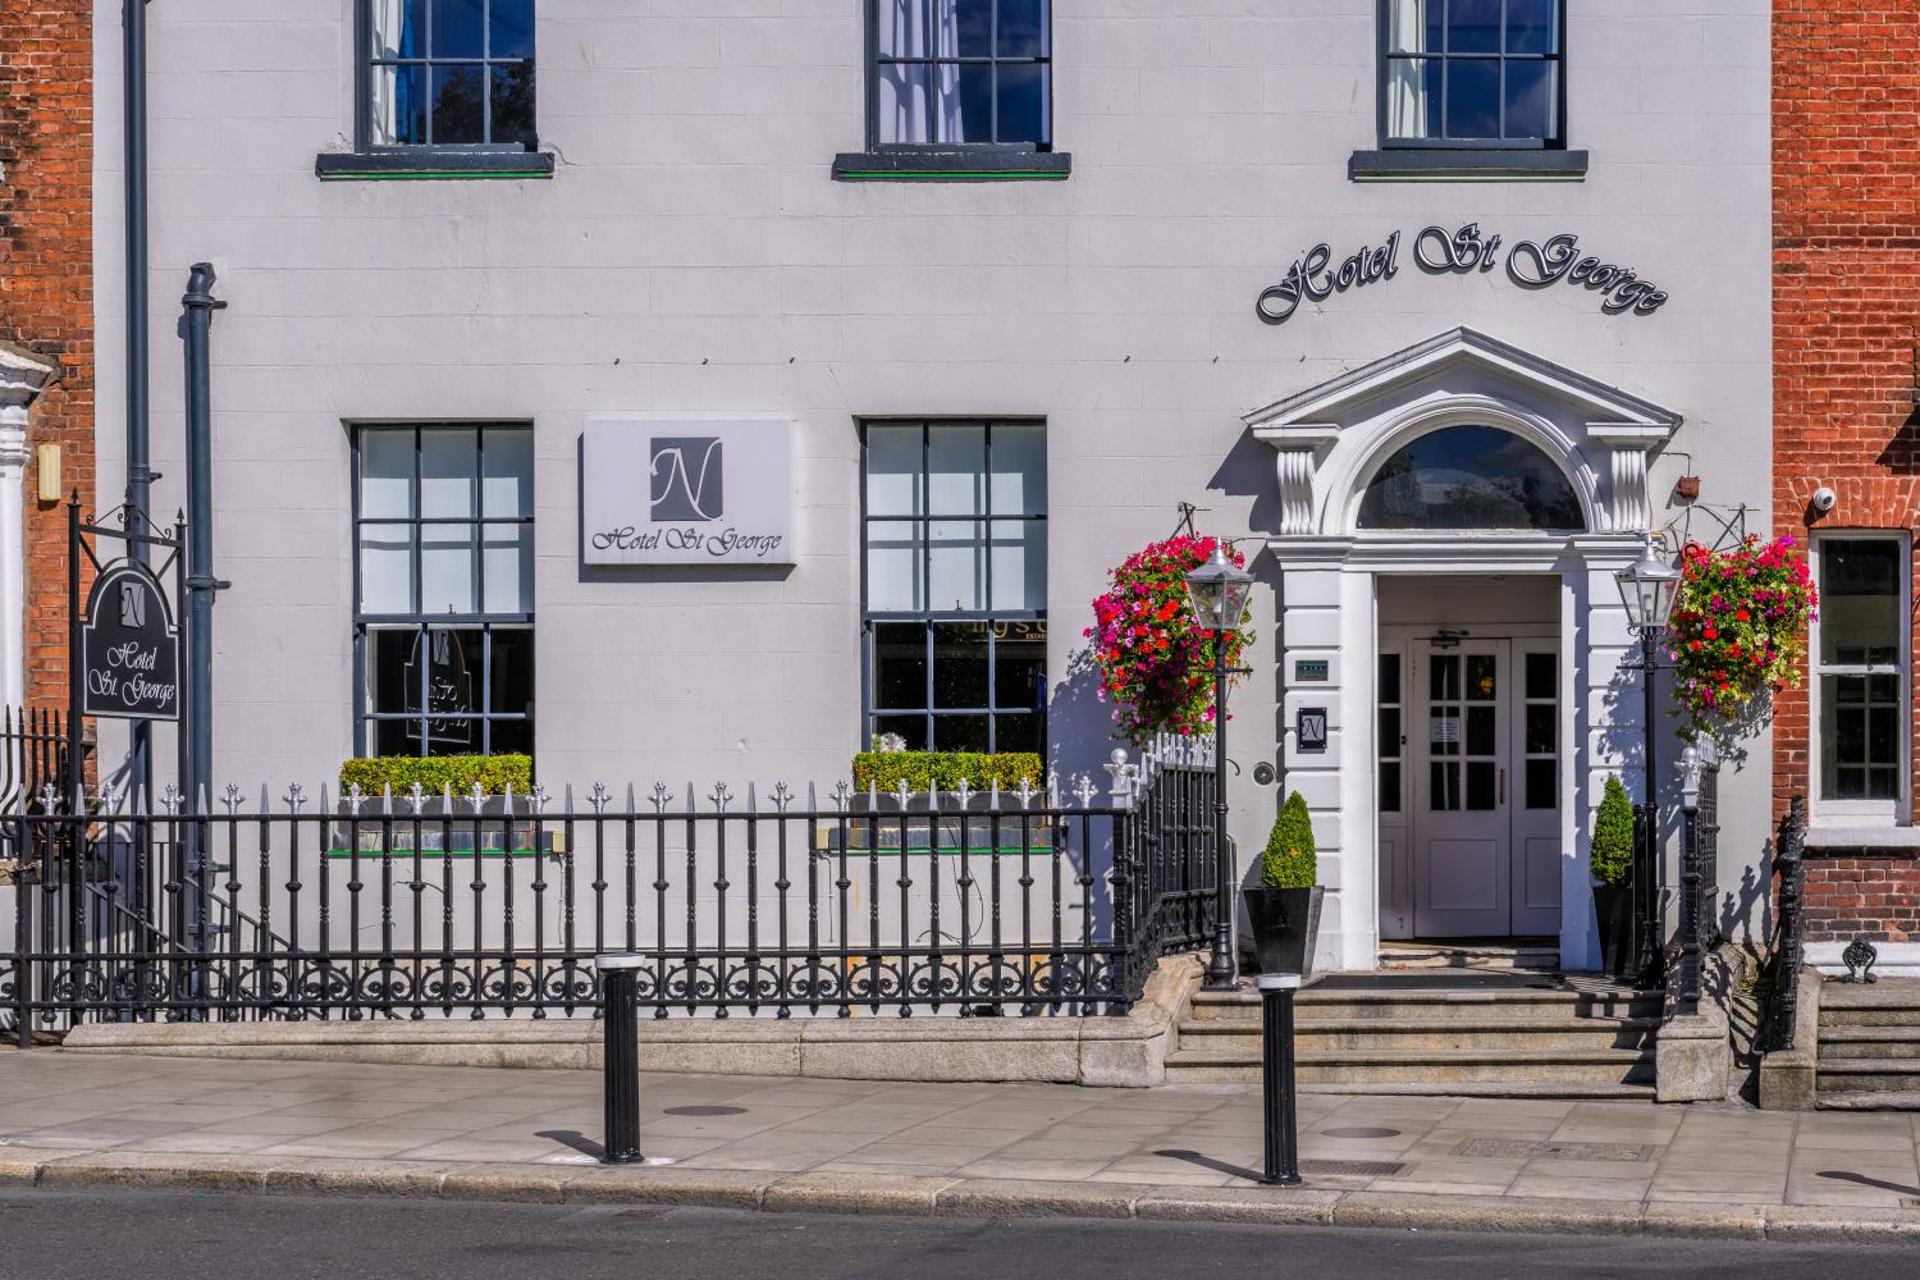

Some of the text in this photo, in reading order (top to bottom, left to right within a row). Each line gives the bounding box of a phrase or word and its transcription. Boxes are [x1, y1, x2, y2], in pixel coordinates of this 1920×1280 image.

[1259, 222, 1668, 319] Hotel St George
[592, 526, 783, 557] Hotel St George
[107, 641, 157, 670] Hotel
[89, 669, 175, 709] St George
